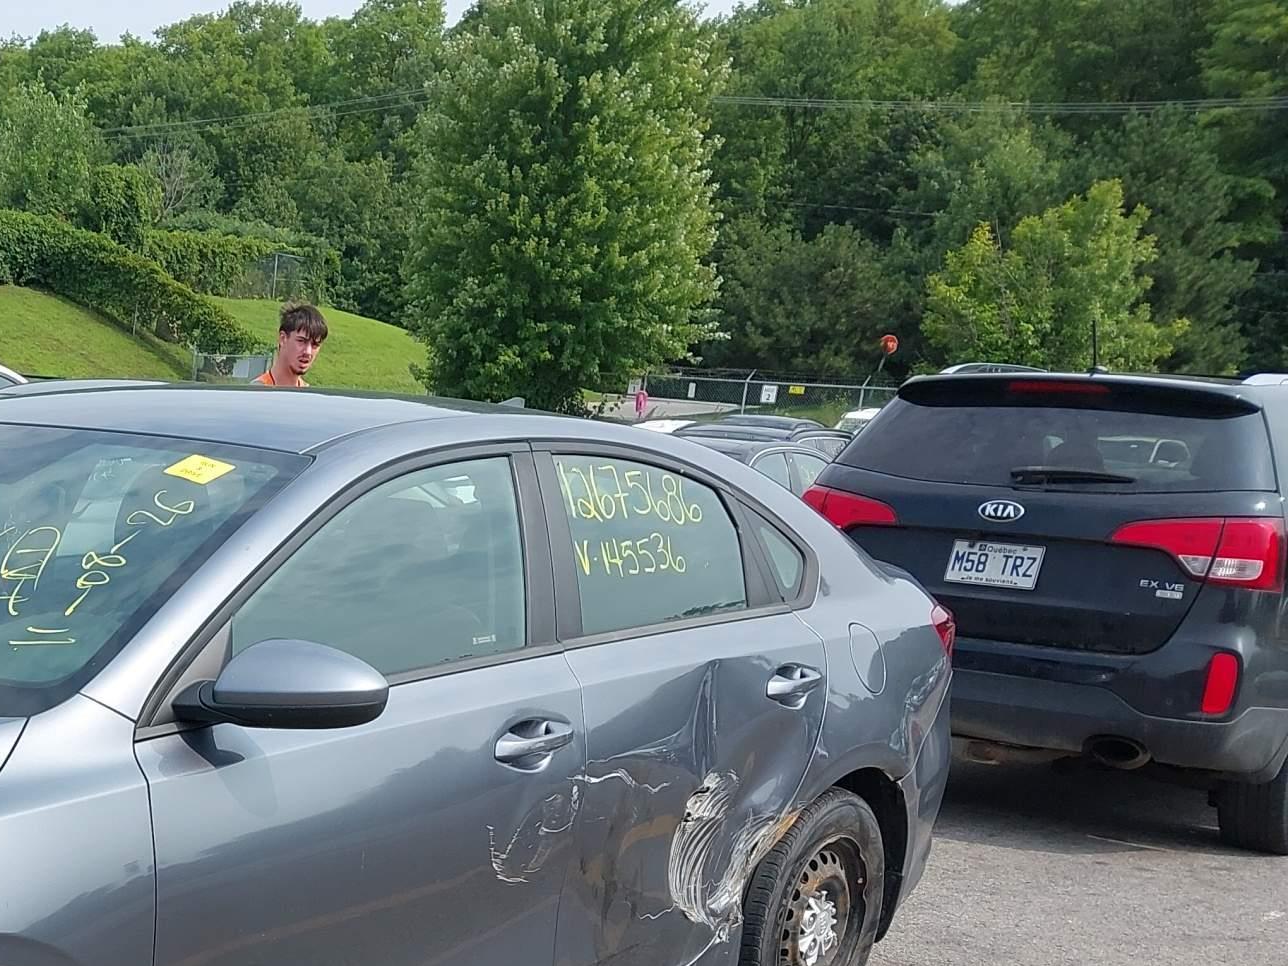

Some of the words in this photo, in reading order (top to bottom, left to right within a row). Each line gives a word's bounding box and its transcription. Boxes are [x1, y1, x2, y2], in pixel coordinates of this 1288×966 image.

[558, 460, 703, 525] 12675686
[984, 503, 1015, 517] KIA
[987, 546, 1018, 555] Québec
[951, 550, 989, 573] M58
[1001, 554, 1037, 577] TRZ
[1139, 579, 1160, 588] EX
